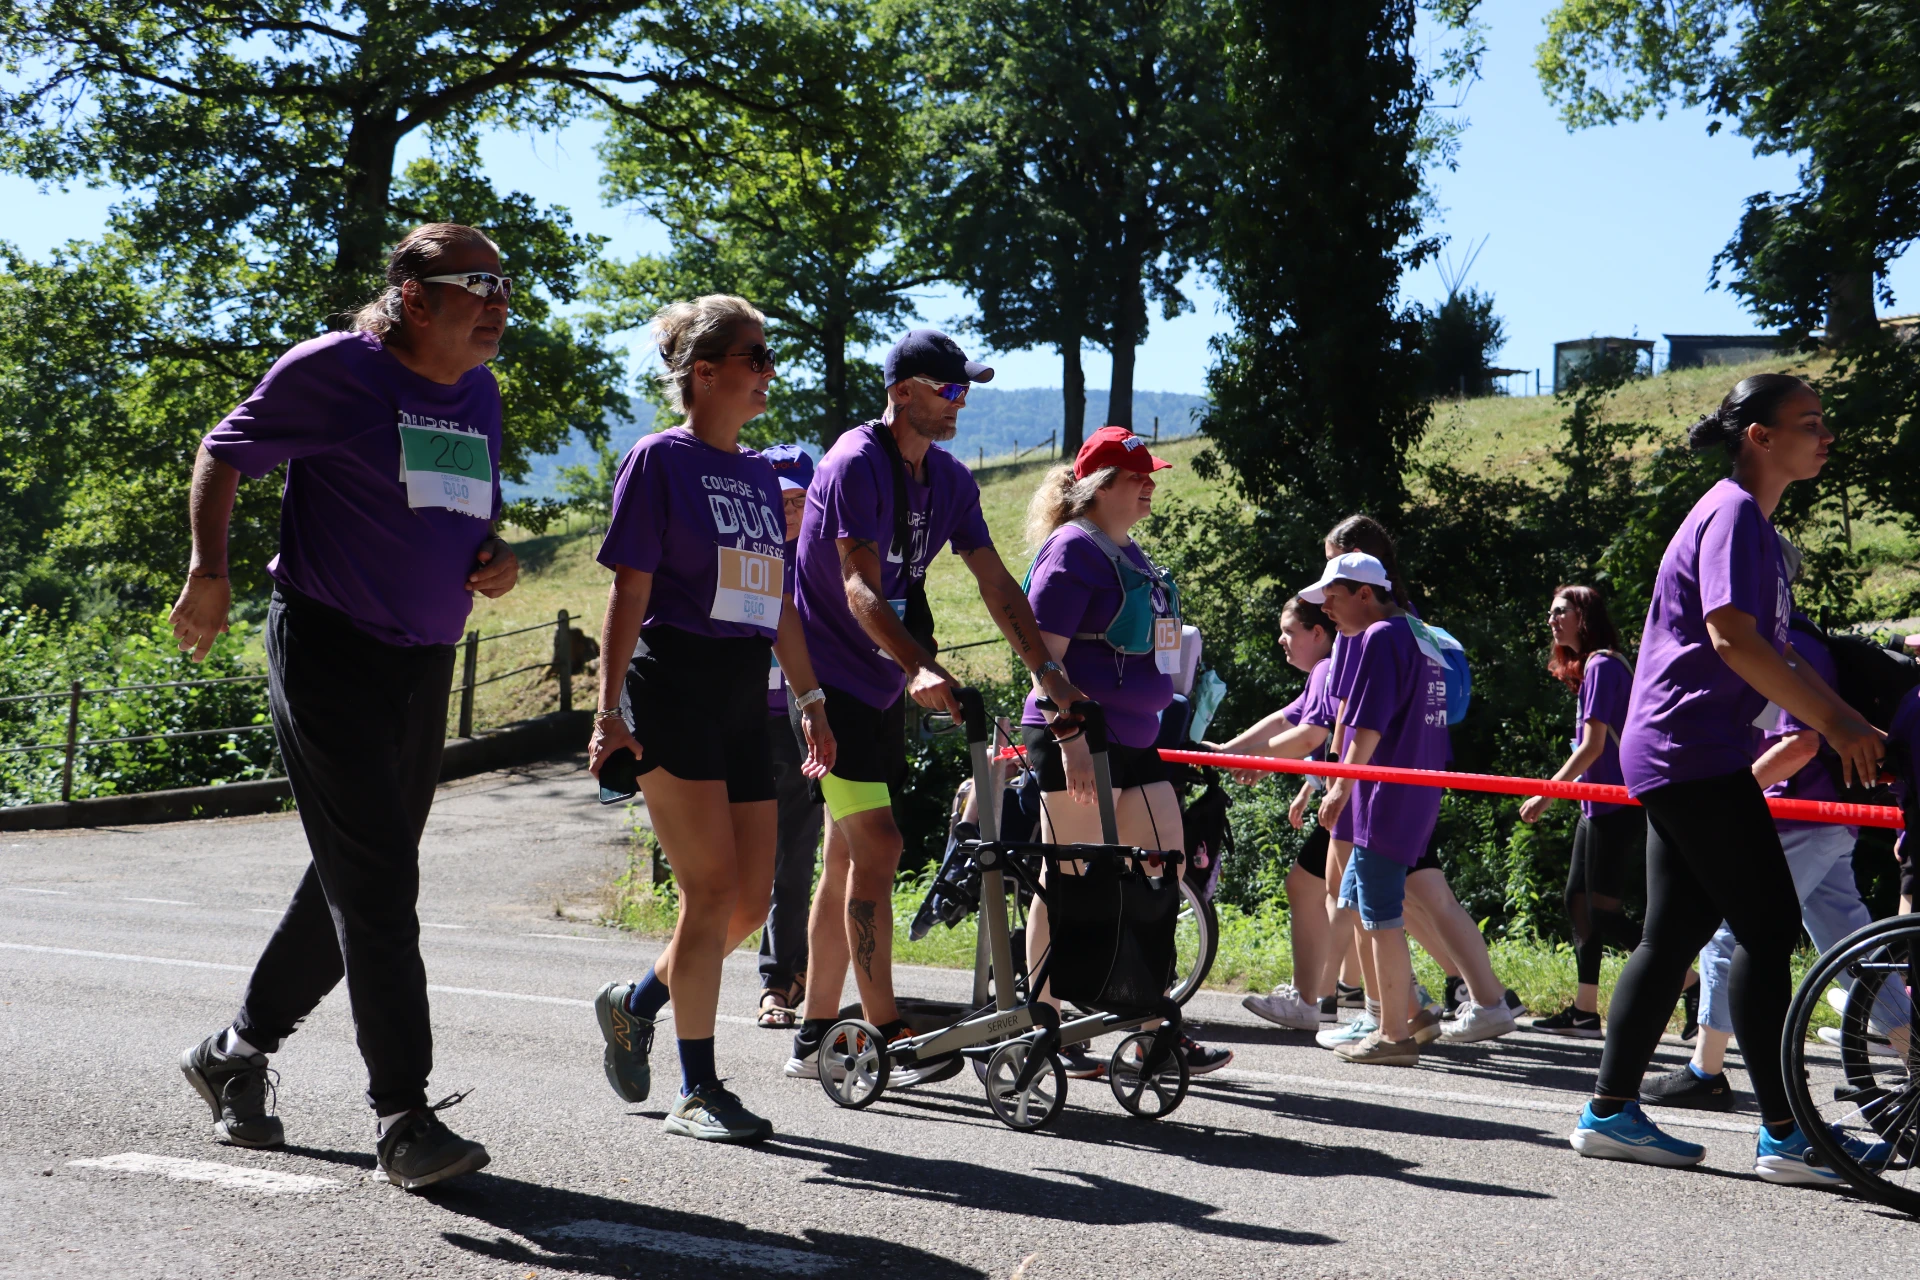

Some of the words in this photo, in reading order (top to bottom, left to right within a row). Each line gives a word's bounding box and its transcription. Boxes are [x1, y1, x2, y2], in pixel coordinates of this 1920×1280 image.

[430, 435, 474, 471] 20
[443, 481, 469, 500] DUO
[701, 475, 754, 498] COURSE
[708, 495, 784, 545] DUO
[740, 555, 770, 592] 101
[744, 599, 765, 616] DUO
[987, 1015, 1019, 1033] SERVER
